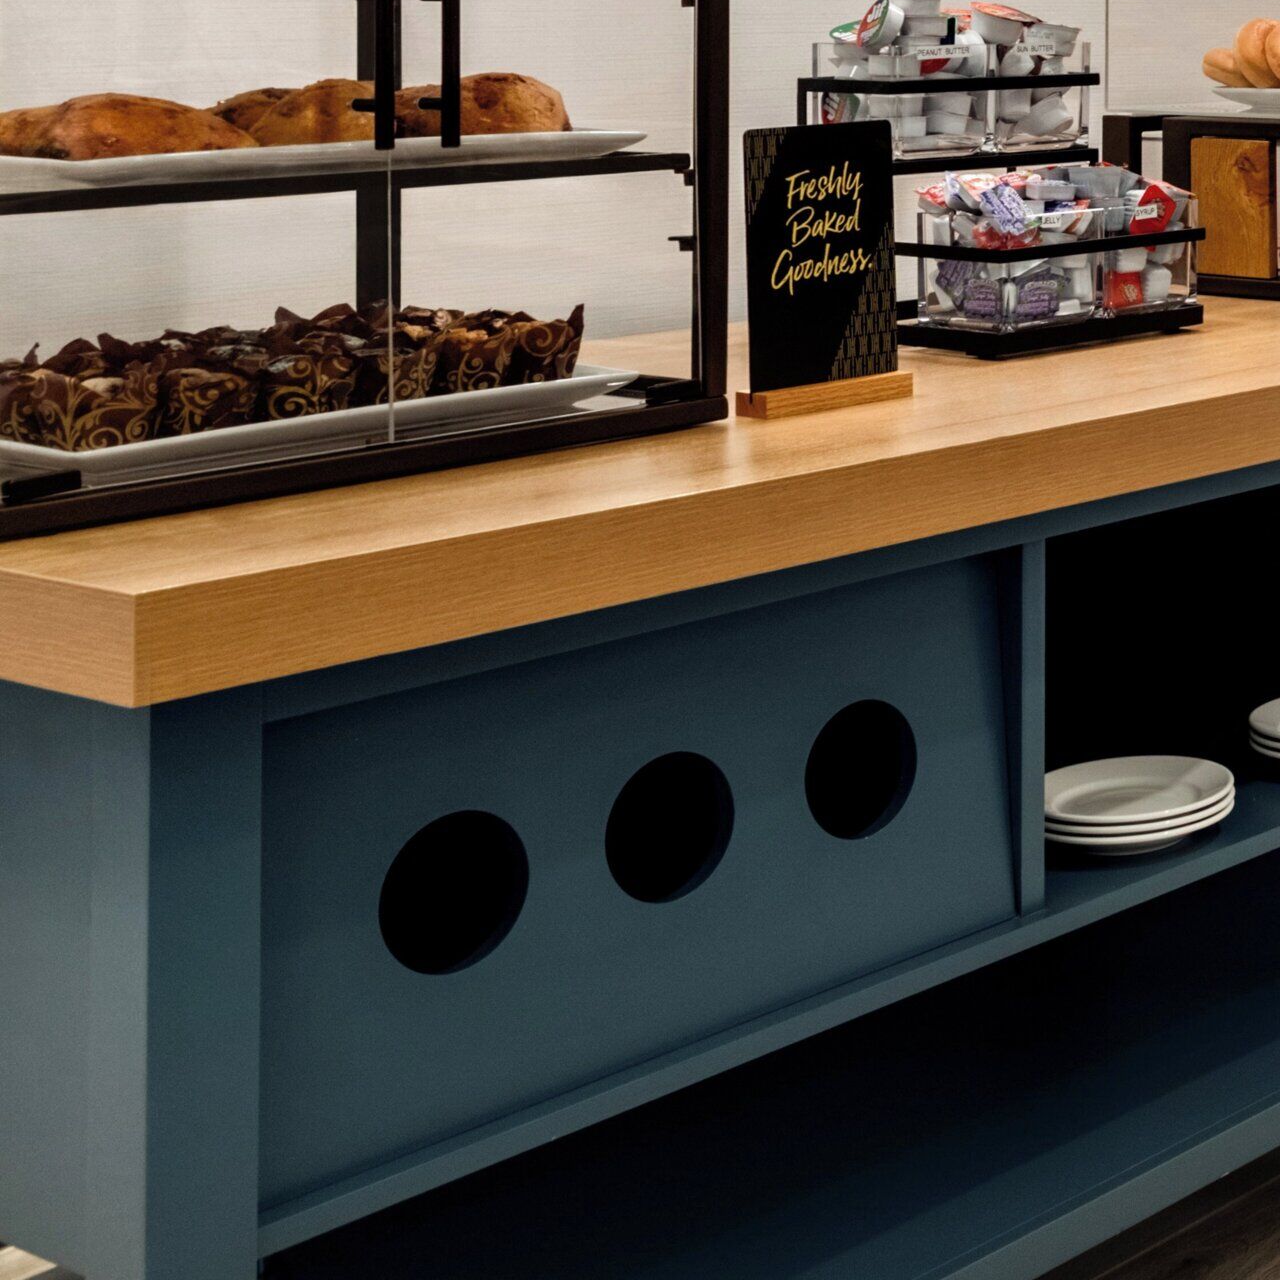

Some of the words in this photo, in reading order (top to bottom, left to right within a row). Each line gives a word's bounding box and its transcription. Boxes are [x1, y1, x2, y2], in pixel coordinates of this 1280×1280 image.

[917, 48, 943, 57] PEANUT
[945, 46, 970, 55] BUTTER
[1030, 44, 1054, 53] BUTTER
[785, 160, 863, 209] Freshly
[785, 198, 861, 247] Baked
[1042, 216, 1061, 225] JELLY
[771, 243, 872, 295] Goodness.
